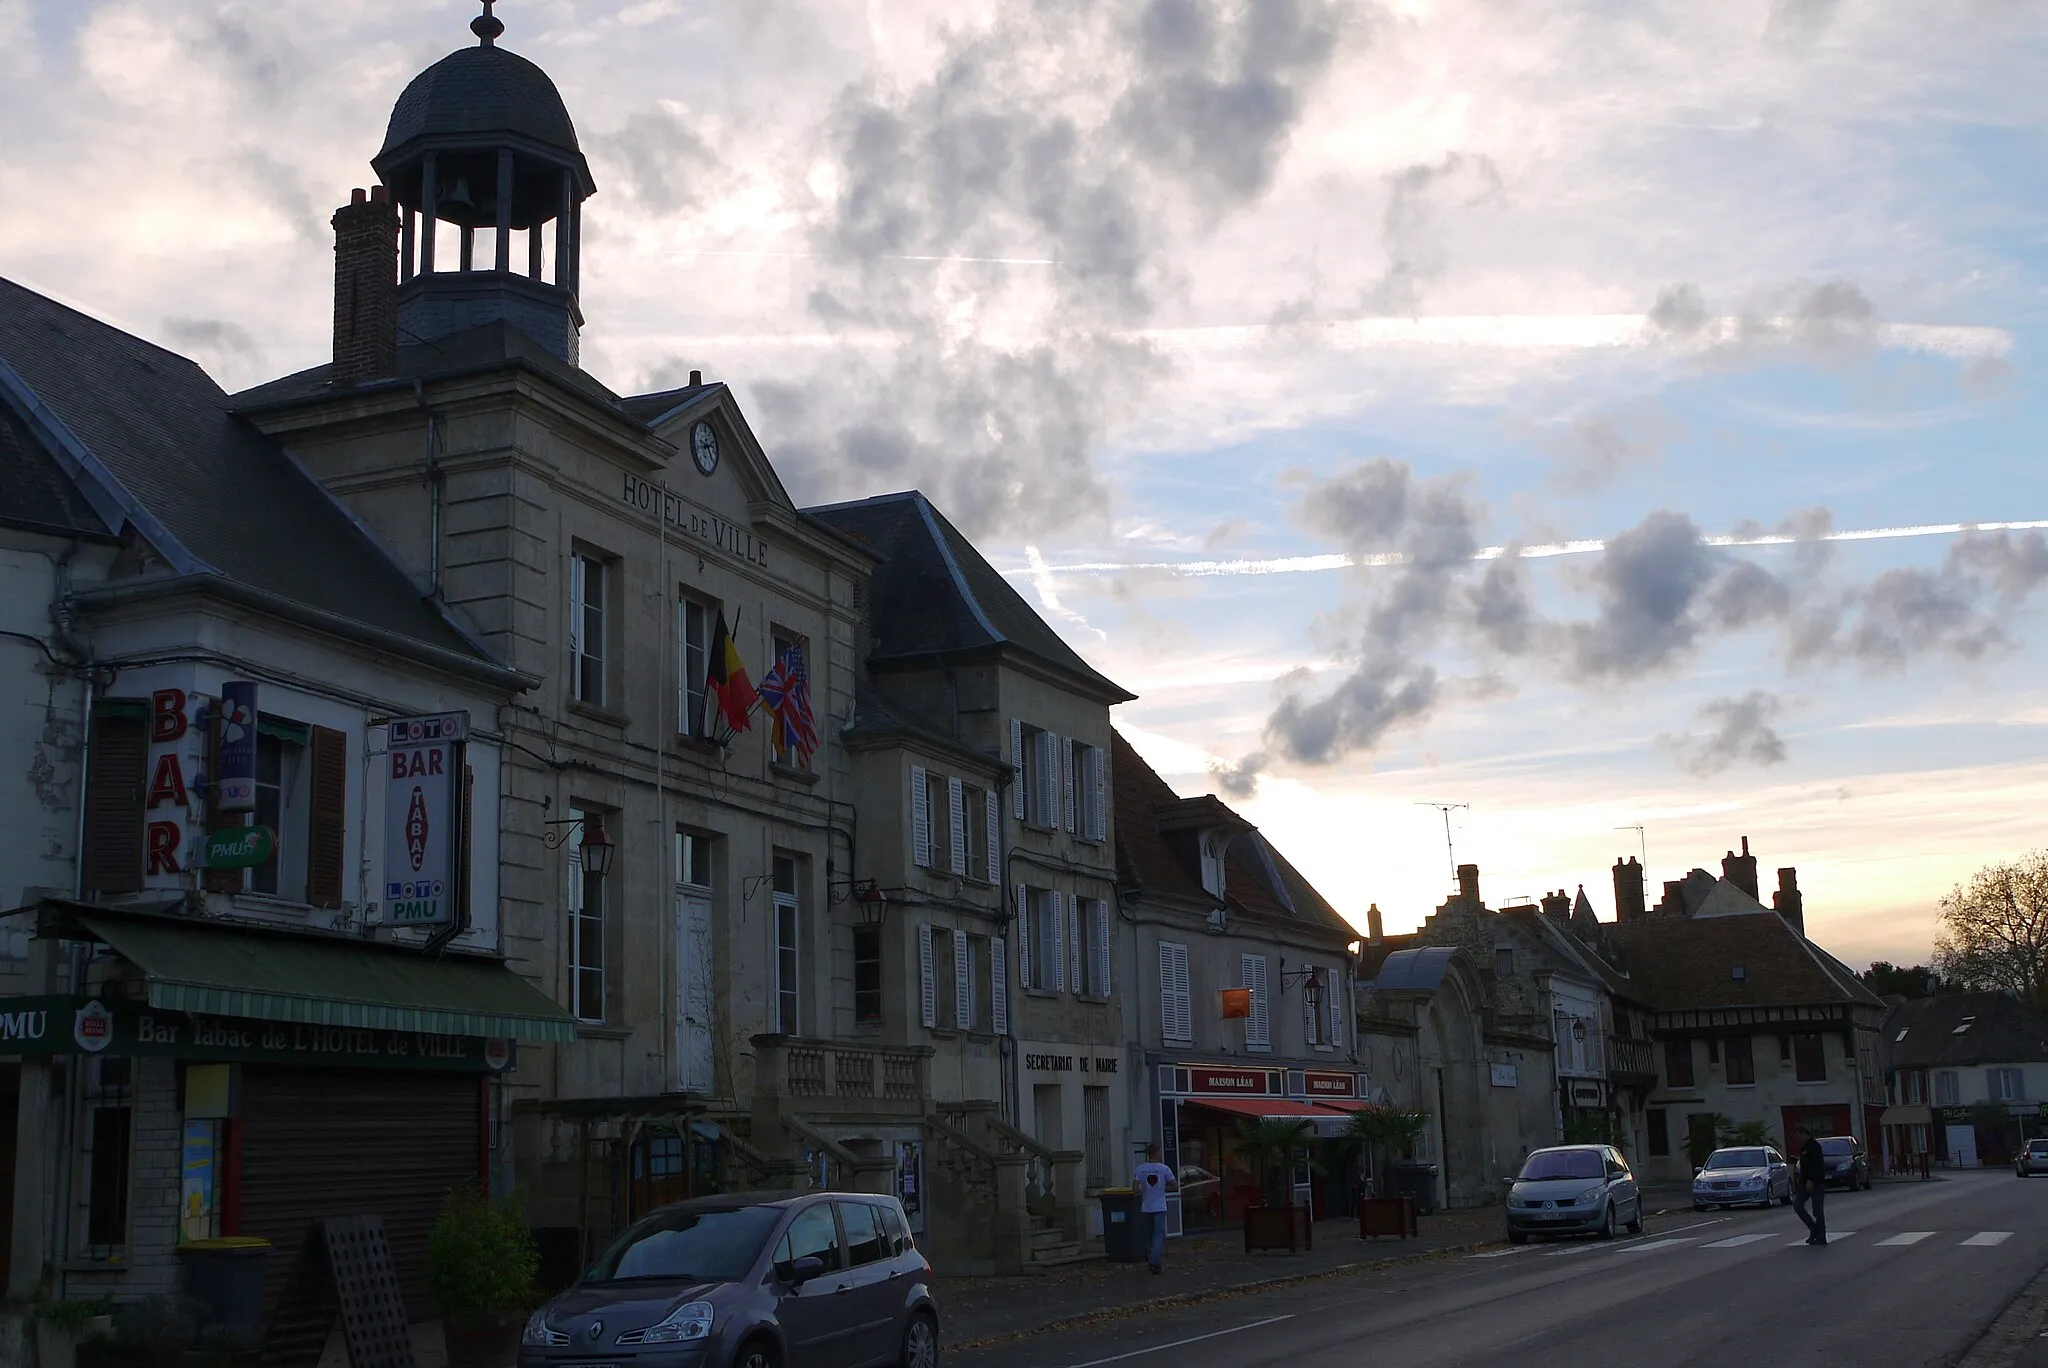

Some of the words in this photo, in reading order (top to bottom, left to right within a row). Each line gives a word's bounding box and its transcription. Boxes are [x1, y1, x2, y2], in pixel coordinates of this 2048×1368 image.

[691, 514, 708, 539] DE
[712, 518, 768, 569] VILLE
[391, 718, 456, 742] LOTO
[392, 749, 444, 779] BAR
[146, 688, 189, 875] BAR
[410, 791, 424, 869] TABAC
[387, 880, 445, 900] LOTO
[393, 901, 437, 920] PMU
[137, 1015, 179, 1044] Bar
[190, 1018, 252, 1048] Tabac
[261, 1024, 288, 1050] de
[294, 1026, 379, 1054] L'HOTEL
[386, 1035, 408, 1056] de
[416, 1036, 467, 1059] VILLE
[1026, 1053, 1073, 1072] SECRETARIAT
[1079, 1056, 1089, 1073] DE
[1095, 1057, 1118, 1073] MAIRIE
[1208, 1077, 1235, 1088] MAISON
[1236, 1075, 1254, 1088] LÉAU
[1312, 1080, 1333, 1090] MAISON
